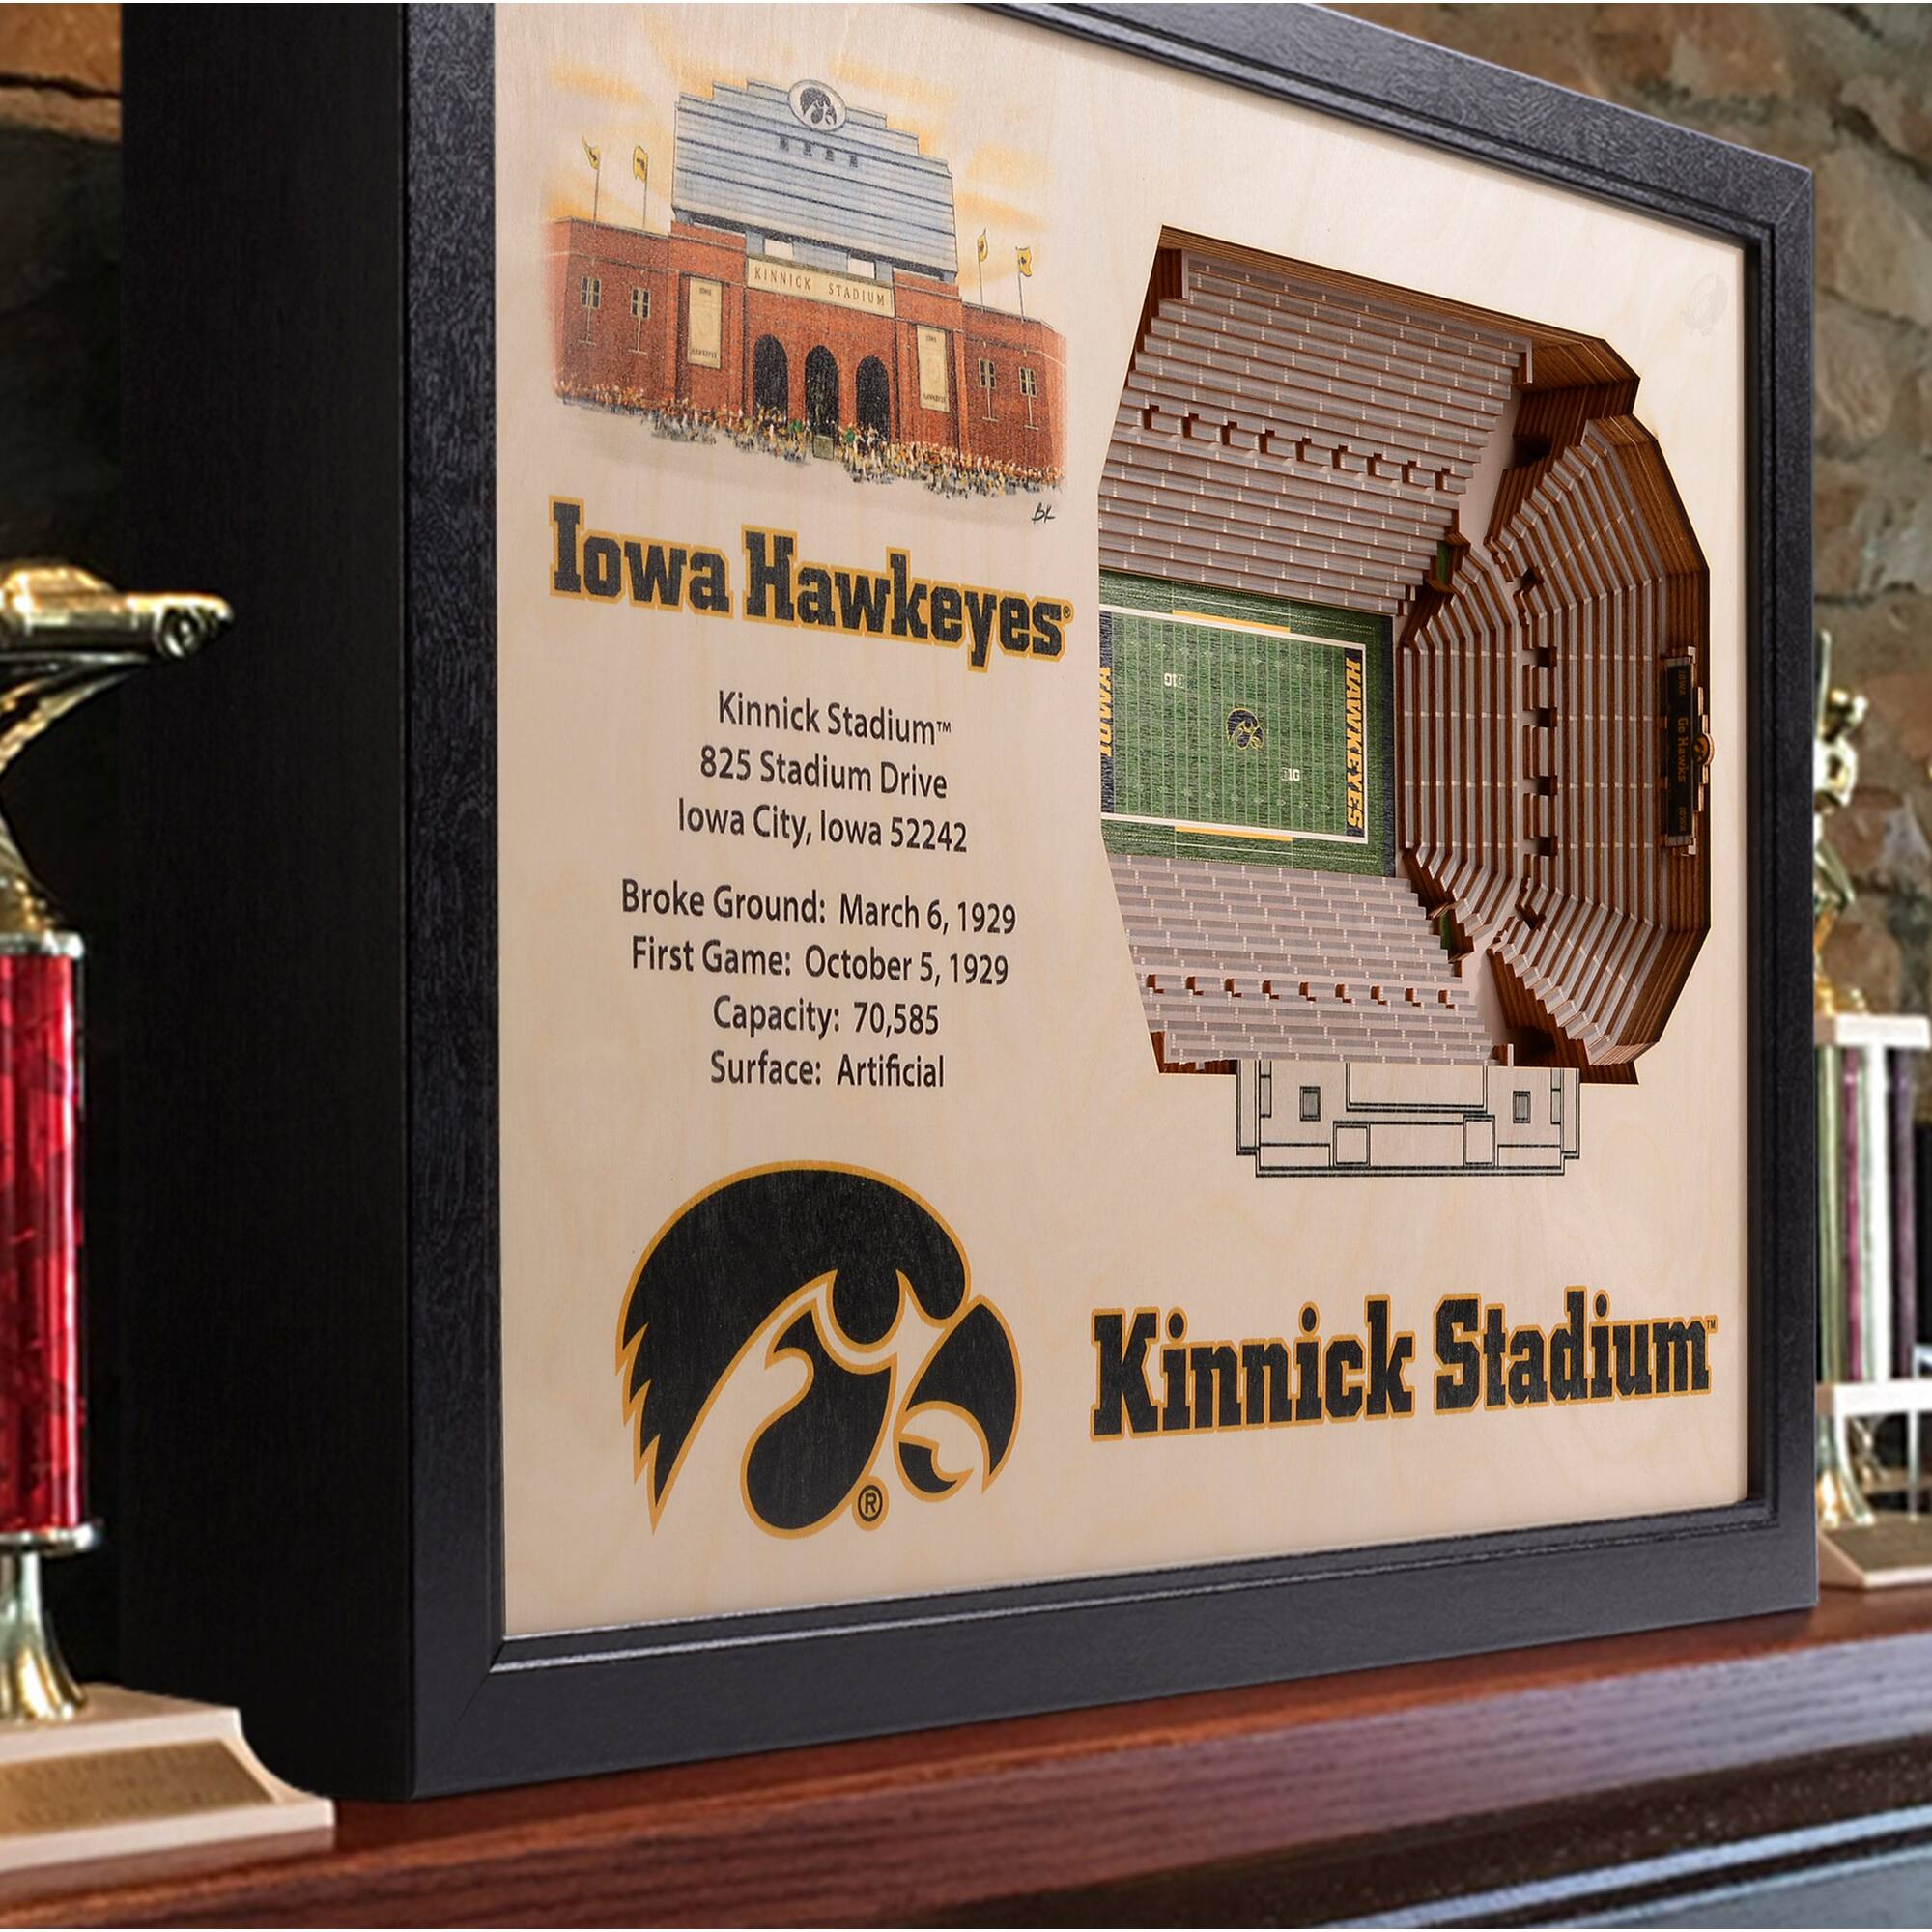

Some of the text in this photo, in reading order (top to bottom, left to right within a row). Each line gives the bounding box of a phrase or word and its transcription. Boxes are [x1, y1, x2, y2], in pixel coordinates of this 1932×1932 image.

[753, 266, 886, 306] KINNICK STADIUM
[549, 494, 733, 618] Iowa
[720, 691, 820, 733] Kinnick
[1346, 658, 1364, 829] HAWKEYES
[1677, 717, 1690, 782] Go Hawks
[701, 745, 947, 798] 825 Stadium Drive
[679, 798, 966, 852] Iowa City, Iowa 52242
[622, 879, 1015, 935] Broke Ground: March 6, 1929
[633, 935, 1008, 987] First Game: October 5, 1929
[714, 995, 938, 1040] Capacity: 70,585
[711, 1049, 943, 1087] Surface: Artificial
[1090, 1294, 1415, 1442] Kinnick
